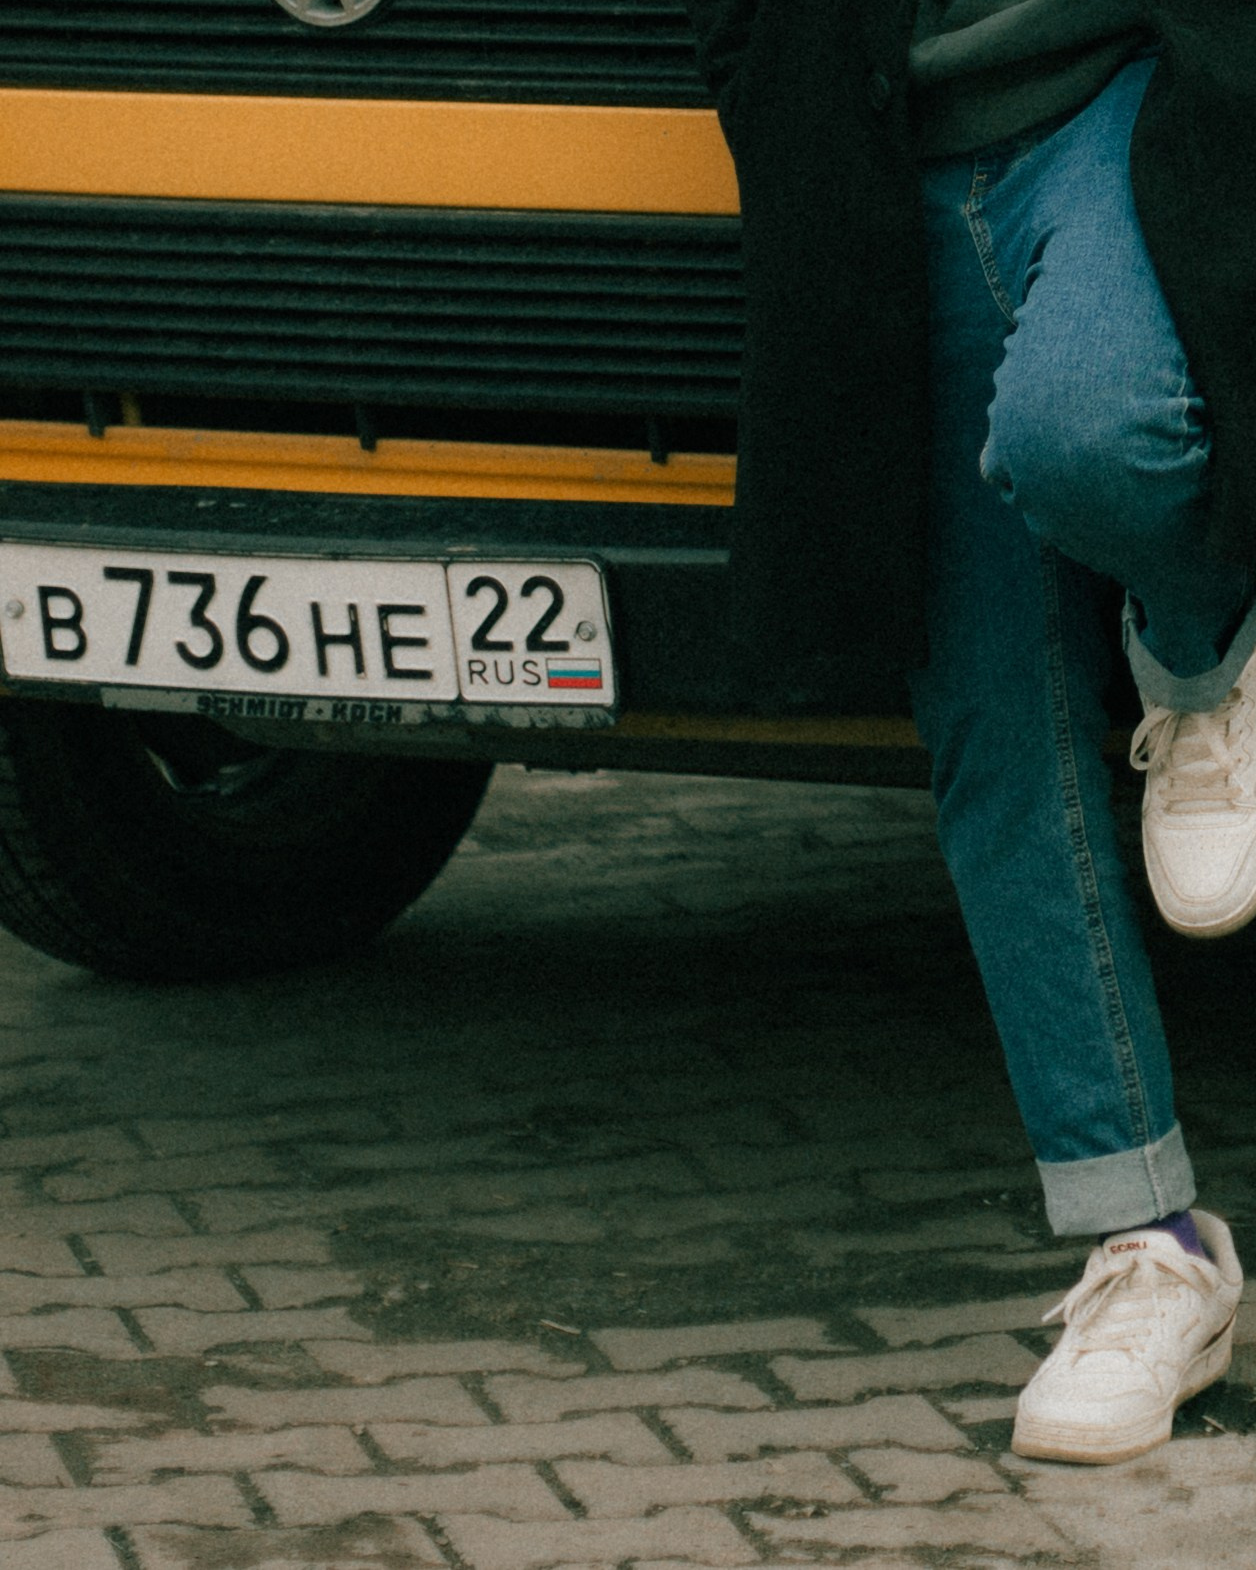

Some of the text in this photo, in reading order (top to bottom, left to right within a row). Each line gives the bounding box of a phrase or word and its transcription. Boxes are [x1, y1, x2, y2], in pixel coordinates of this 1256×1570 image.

[465, 575, 570, 653] 22
[467, 659, 542, 686] RUS
[197, 694, 402, 723] SCHMIDT KOCH
